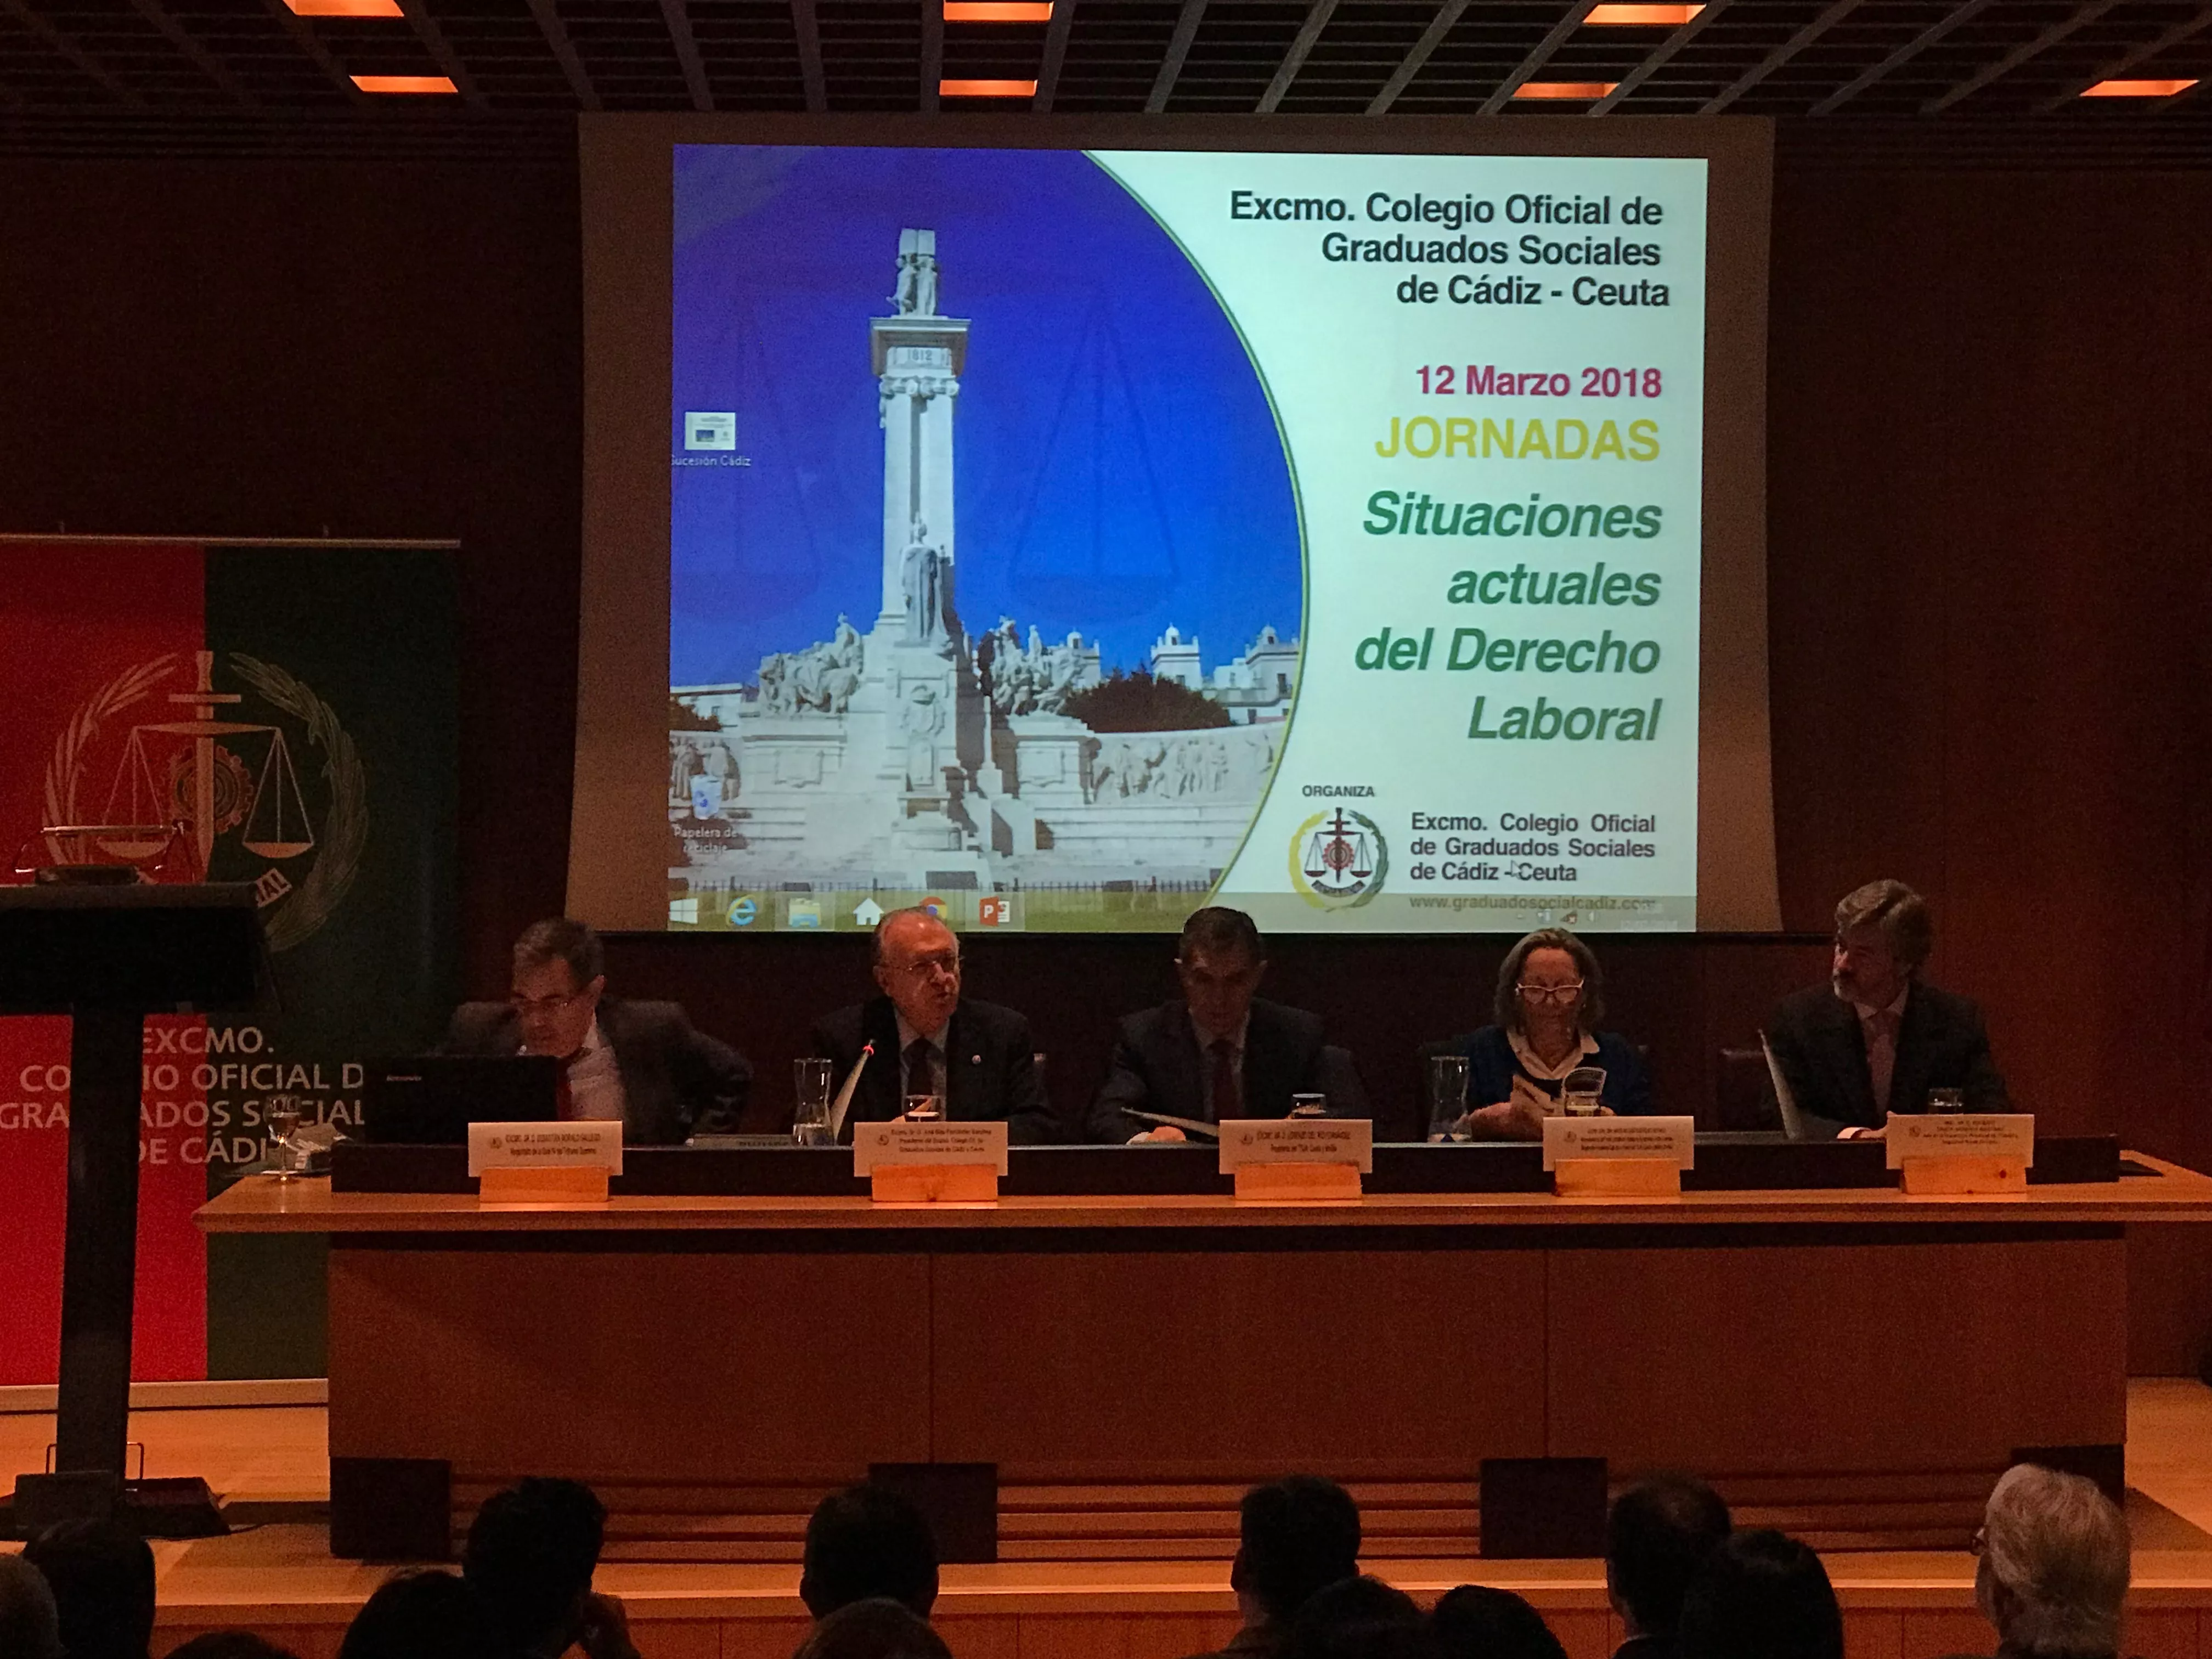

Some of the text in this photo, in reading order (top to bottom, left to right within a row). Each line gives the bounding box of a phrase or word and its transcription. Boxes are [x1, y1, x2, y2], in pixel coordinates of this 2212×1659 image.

[1231, 190, 1663, 230] Excmo. Colegio Oficial de
[1322, 232, 1661, 266] Graduados Sociales
[1397, 274, 1439, 304] de
[1448, 273, 1542, 305] Cádiz
[1572, 276, 1670, 307] Ceuta
[1417, 365, 1662, 398] 12 Marzo 2018
[1375, 416, 1661, 462] JORNADAS
[1363, 490, 1664, 539] Situaciones
[1447, 562, 1662, 607] actuales
[1355, 627, 1661, 674] del Derecho
[1468, 696, 1663, 741] Laboral
[1302, 785, 1375, 797] ORGANIZA
[1412, 812, 1656, 836] Excmo. Colegio Oficial
[1410, 837, 1656, 858] de Graduados Sociales
[1410, 862, 1436, 881] de
[1441, 861, 1499, 881] Cádiz
[1517, 862, 1577, 882] Ceuta
[20, 1064, 179, 1091] COIO
[191, 1063, 330, 1091] OFICIAL
[0, 1100, 230, 1129] GRAADOS
[179, 1131, 267, 1164] CÁDI
